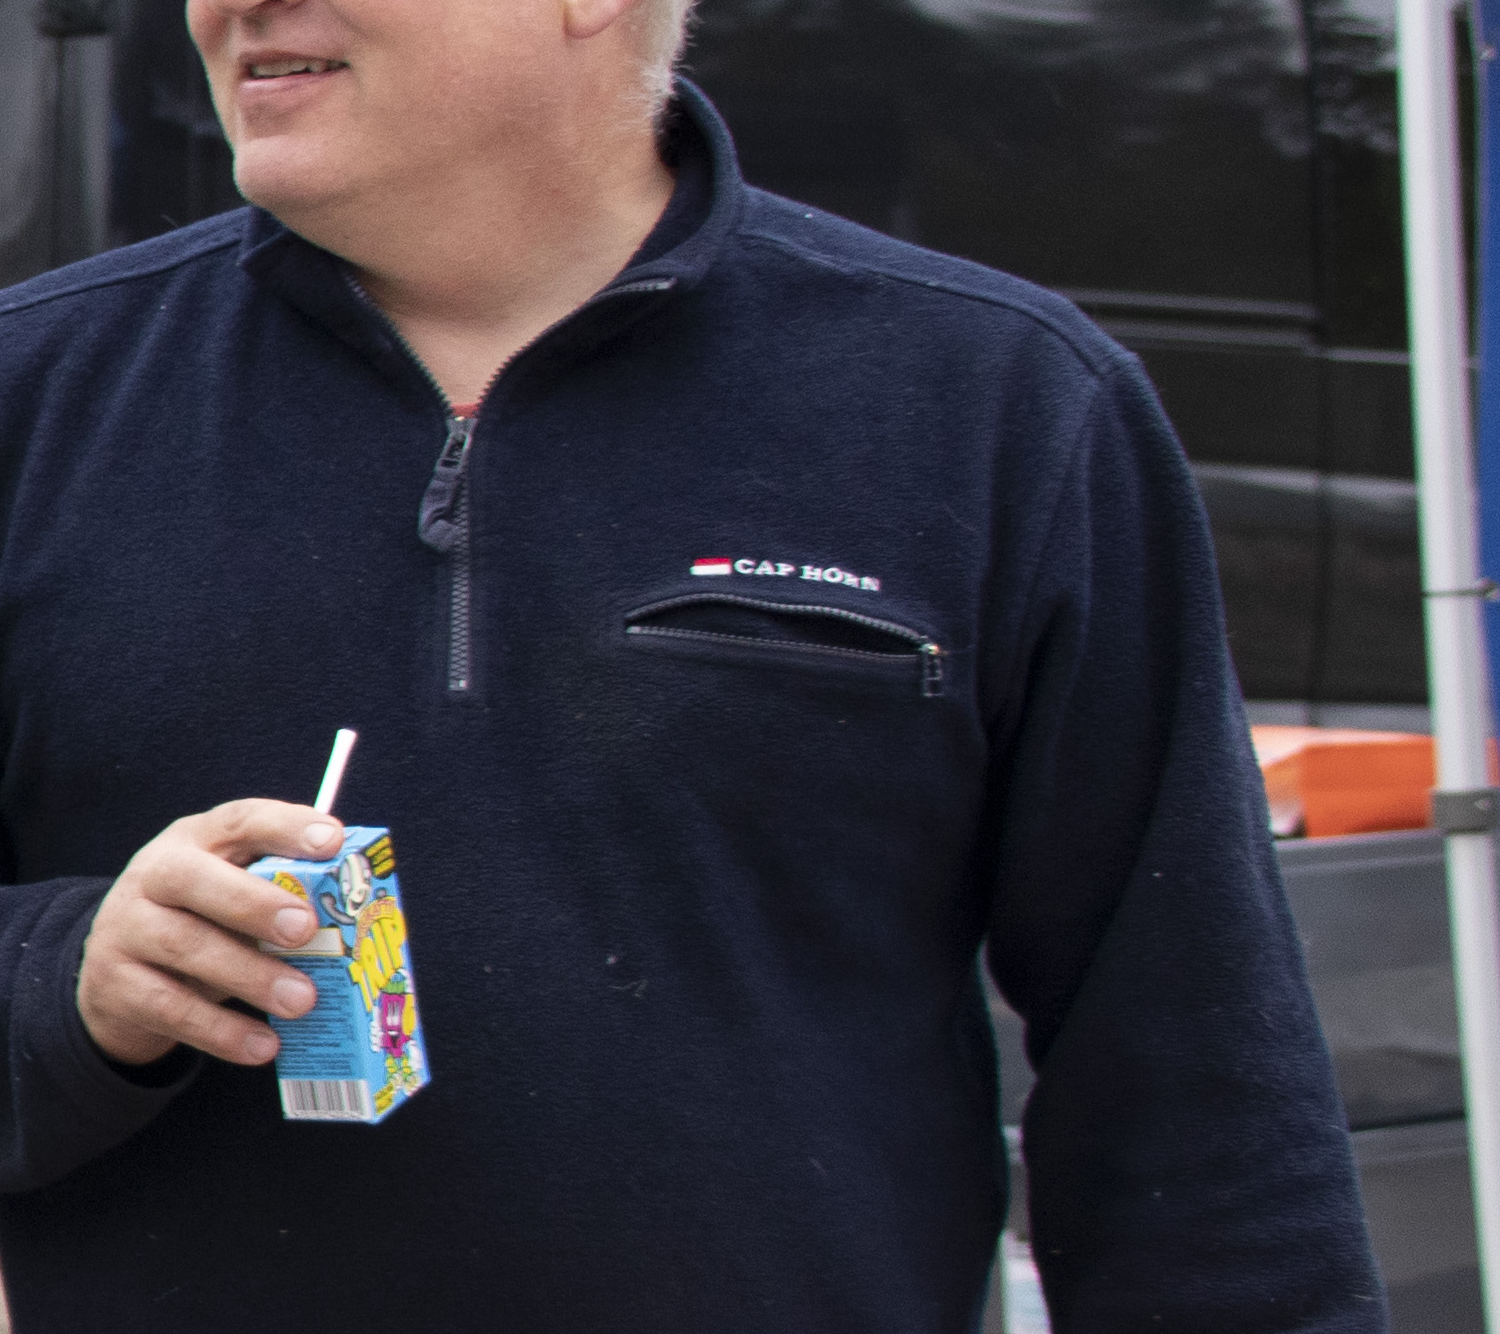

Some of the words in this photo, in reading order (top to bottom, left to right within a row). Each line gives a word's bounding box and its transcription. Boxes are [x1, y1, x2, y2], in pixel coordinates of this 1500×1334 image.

[733, 557, 796, 578] CAP
[799, 564, 881, 592] HORN
[349, 908, 406, 1013] TRIP
